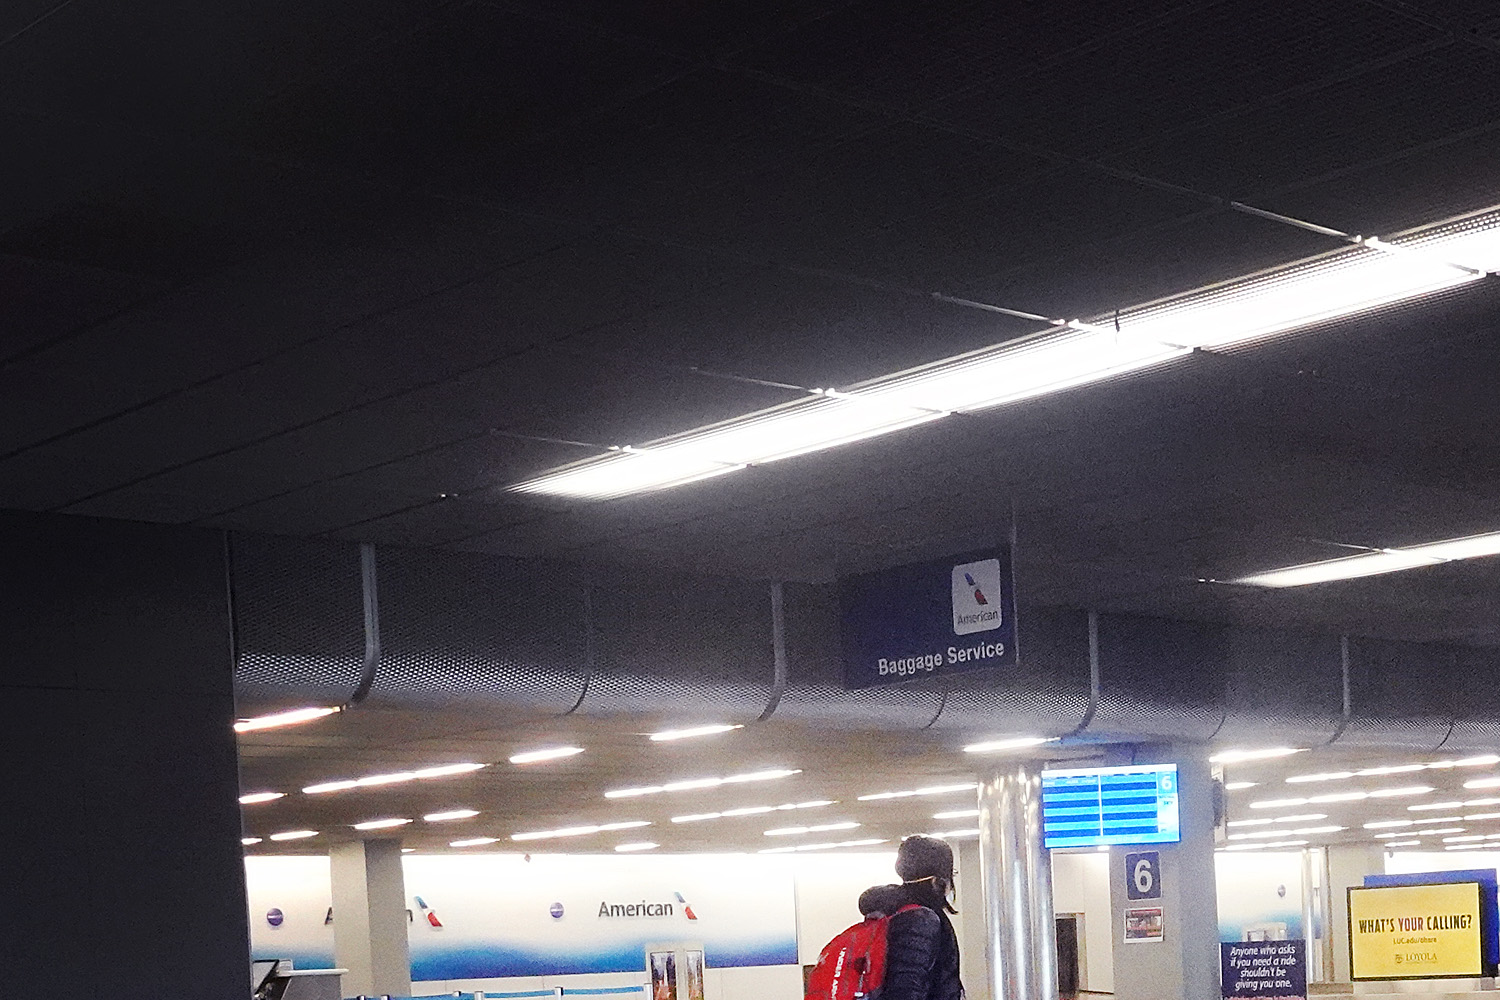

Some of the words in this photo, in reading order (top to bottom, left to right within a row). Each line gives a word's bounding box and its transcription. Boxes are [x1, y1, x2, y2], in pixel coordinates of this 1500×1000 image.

[957, 610, 998, 625] American
[878, 653, 943, 676] Baggage
[947, 641, 1005, 663] Service
[1162, 775, 1173, 790] 6
[1134, 859, 1153, 893] 6
[598, 900, 673, 917] American
[1359, 918, 1395, 933] WHAT'S
[1398, 916, 1424, 932] YOUR
[1426, 914, 1472, 931] CALLING?
[1230, 947, 1258, 957] Anyone
[1260, 945, 1276, 954] who
[1278, 944, 1296, 954] asks
[1405, 952, 1438, 961] LOYOLA
[834, 947, 847, 977] NDER
[1230, 957, 1236, 967] if
[1236, 960, 1251, 968] you
[1252, 956, 1272, 966] need
[1280, 955, 1296, 965] ride
[1276, 967, 1287, 976] be
[1235, 979, 1258, 991] giving
[1259, 980, 1274, 990] you
